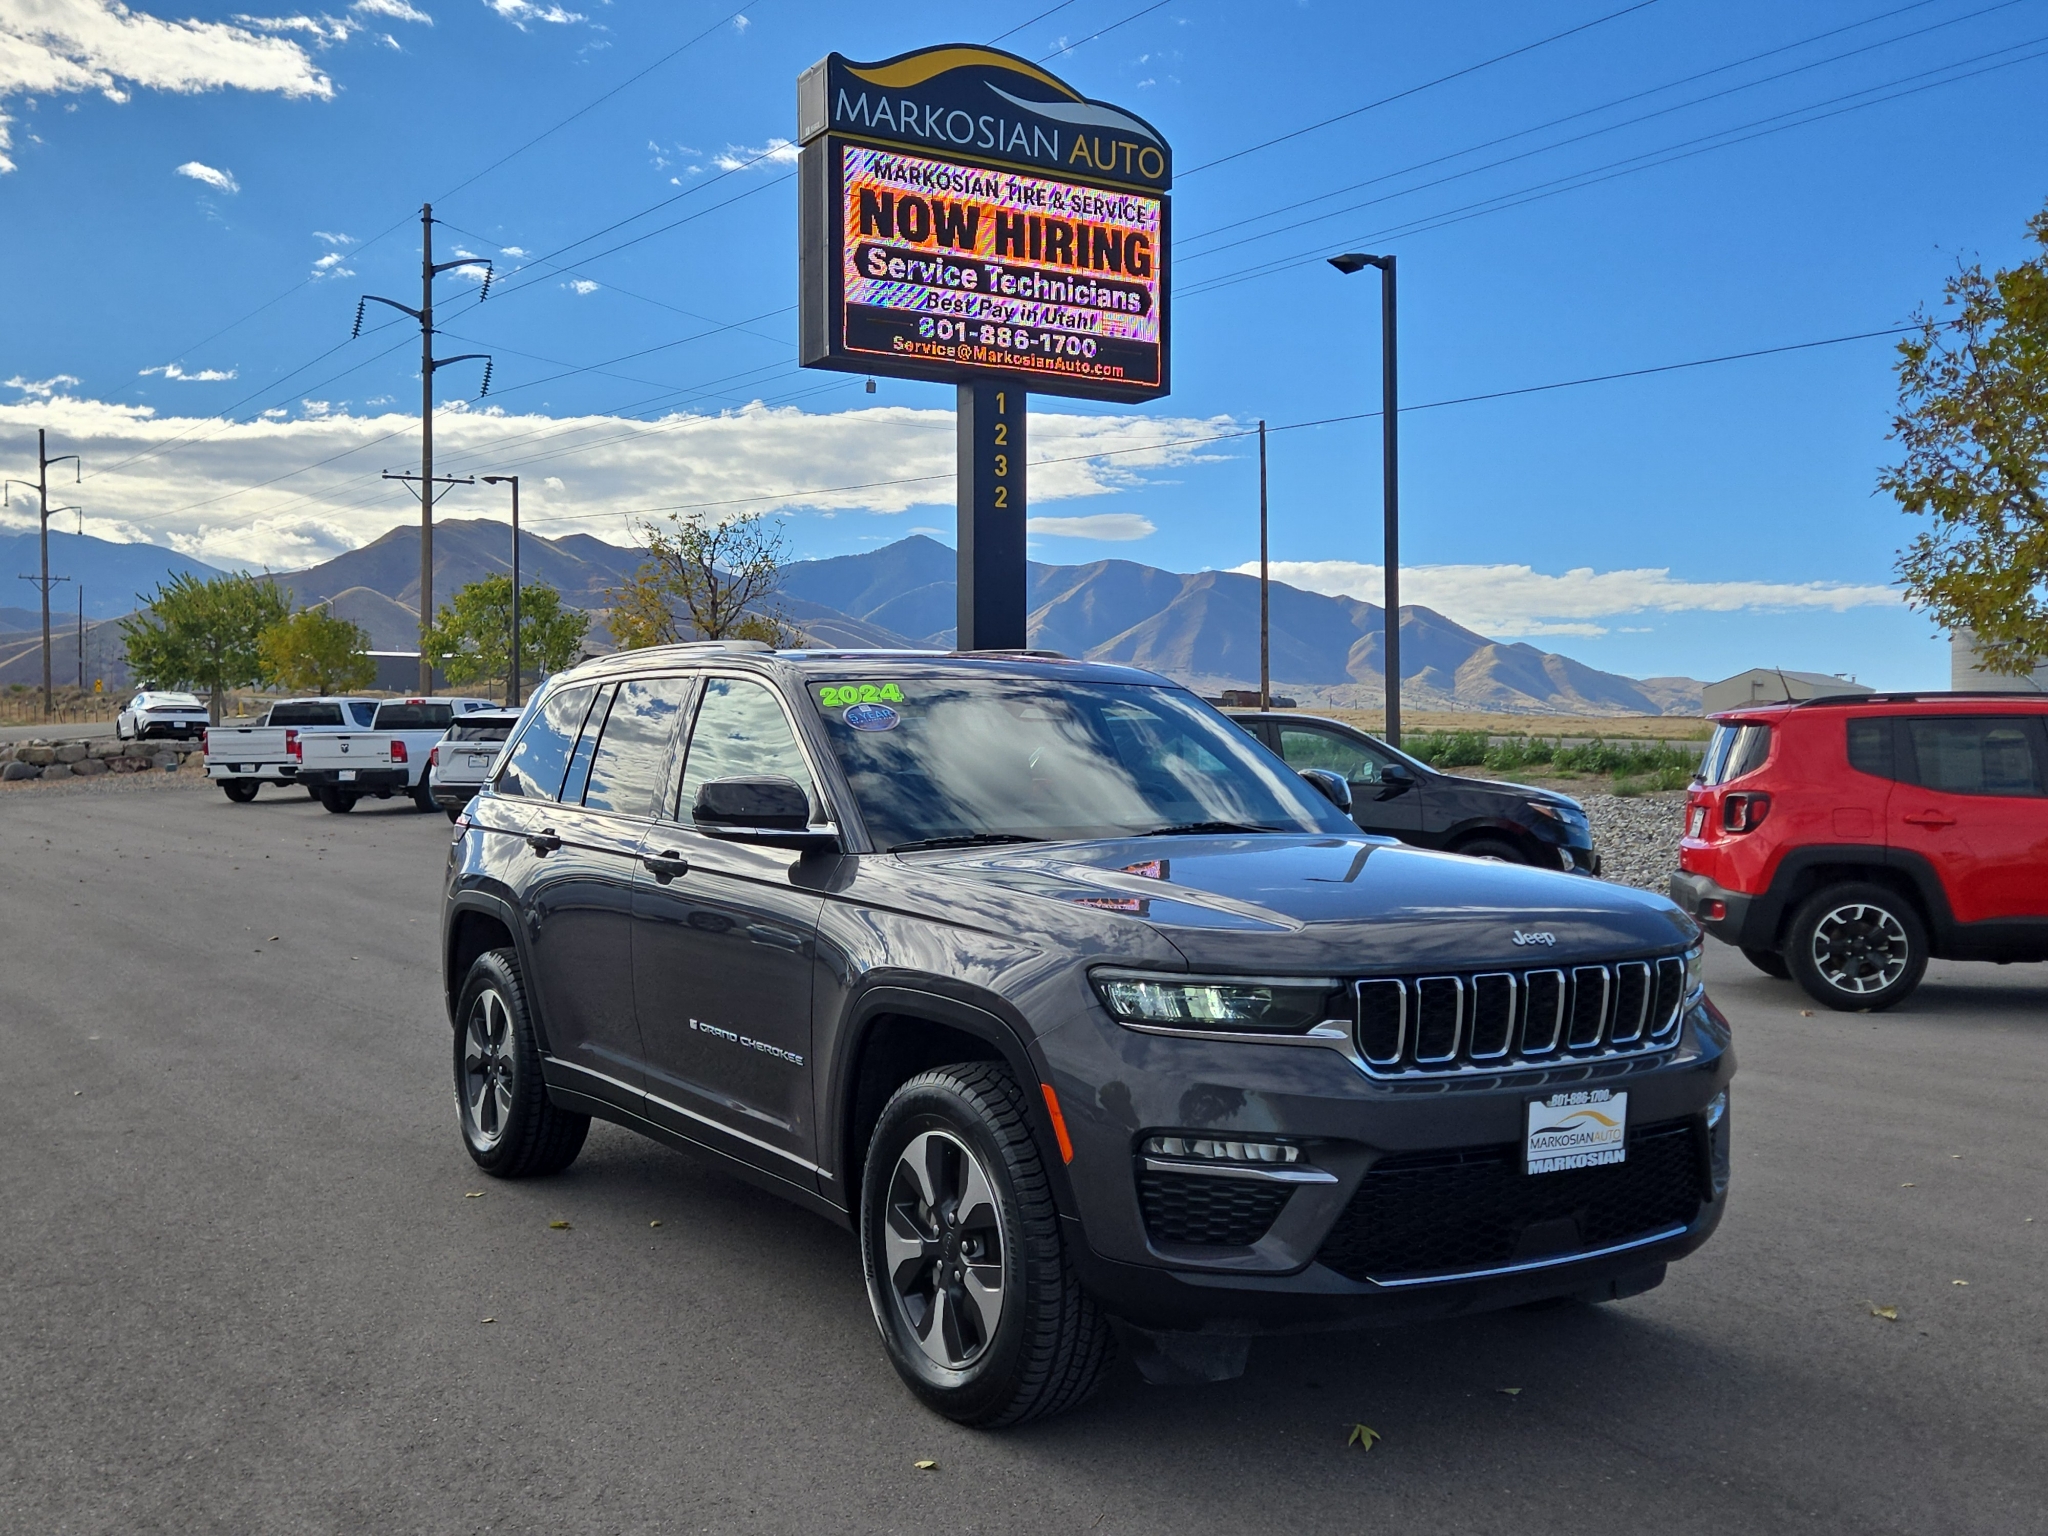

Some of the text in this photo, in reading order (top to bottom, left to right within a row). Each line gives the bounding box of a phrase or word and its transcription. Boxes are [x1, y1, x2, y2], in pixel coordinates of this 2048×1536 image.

[836, 88, 1164, 179] MARKOSIAN AUTO
[874, 159, 1146, 223] MARKOSIAN TIRE & SERVICE
[860, 188, 1151, 277] NOW HIRING
[868, 247, 1142, 313] Service Technicians
[926, 292, 1095, 330] Best Pay in Utah!
[893, 335, 1124, 377] Service@MarkosianAuto.com
[919, 316, 1097, 358] 801-886-1700
[820, 683, 904, 707] 2024
[858, 709, 893, 721] YEAR
[1512, 930, 1556, 947] Jeep
[700, 1022, 804, 1066] GRAND CHEROKEE
[1528, 1149, 1626, 1175] MARKOSIAN
